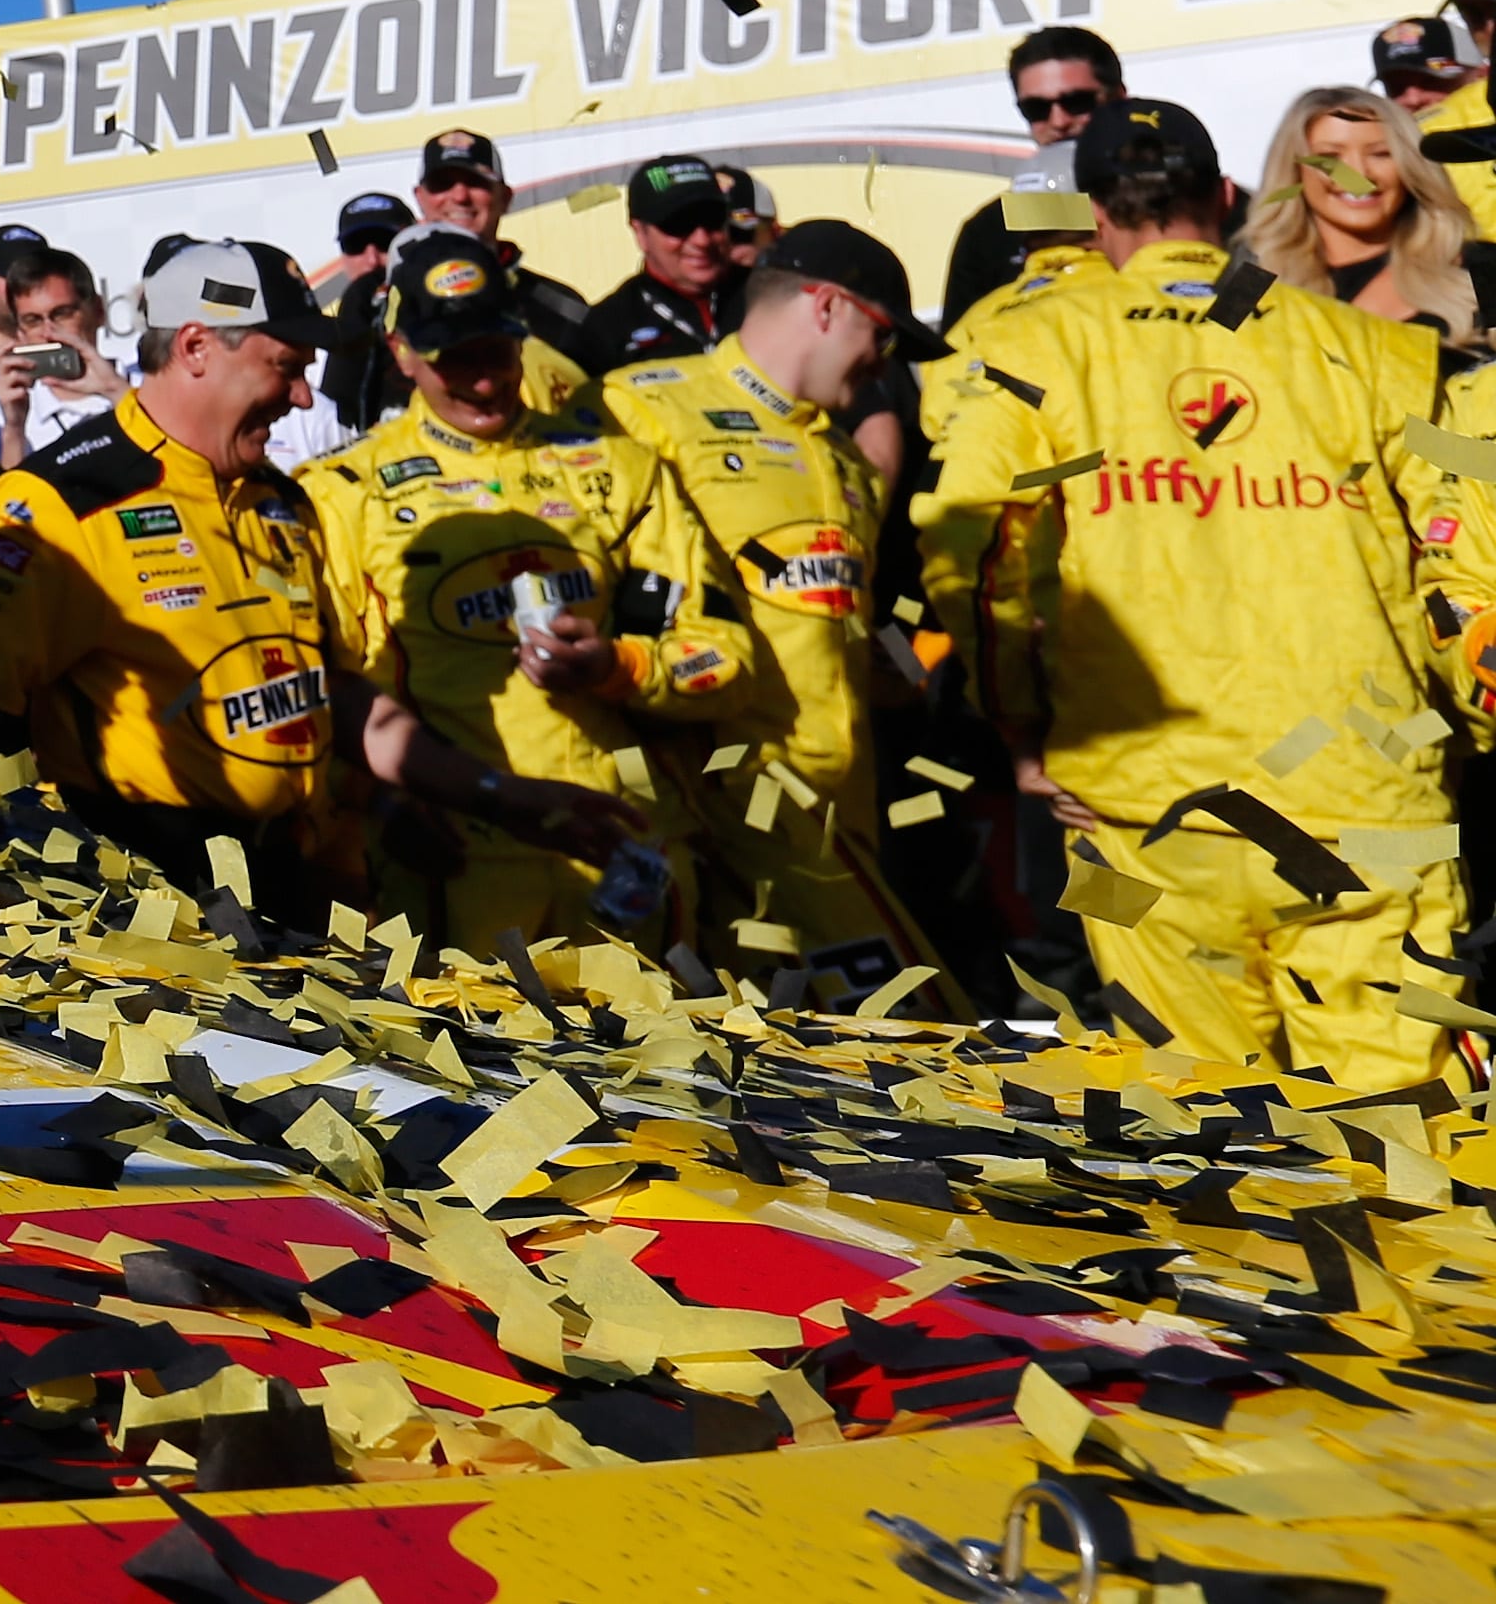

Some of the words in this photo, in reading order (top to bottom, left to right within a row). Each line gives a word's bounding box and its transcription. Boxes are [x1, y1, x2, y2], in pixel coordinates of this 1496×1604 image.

[1092, 459, 1222, 518] jiffy
[1234, 461, 1368, 510] lube
[458, 570, 594, 628] PENOIL
